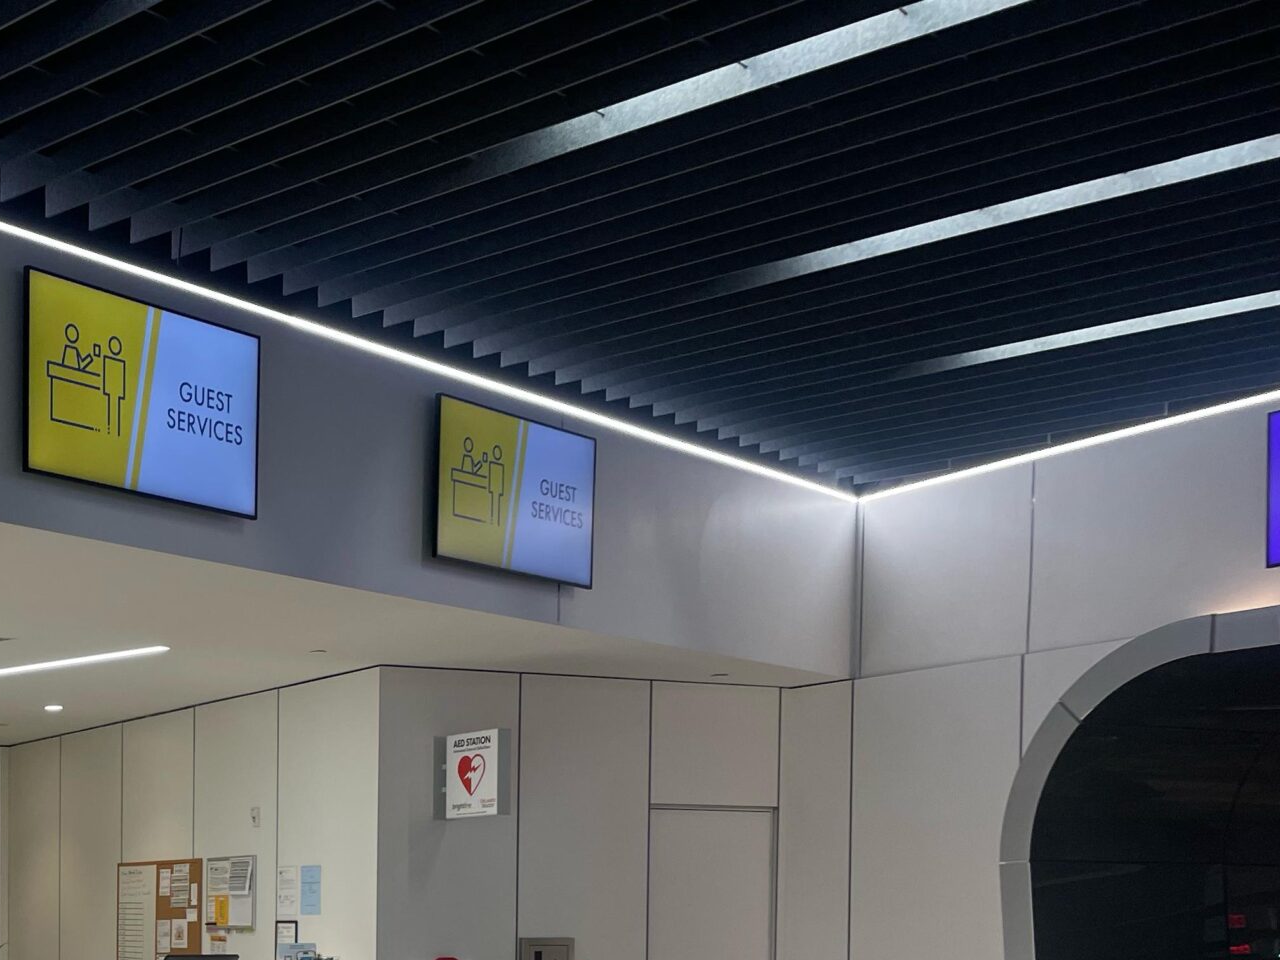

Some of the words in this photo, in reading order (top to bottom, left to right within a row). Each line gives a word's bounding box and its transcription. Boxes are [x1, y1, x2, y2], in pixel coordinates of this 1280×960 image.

[179, 382, 233, 414] GUEST
[167, 408, 243, 445] SERVICES
[540, 479, 577, 503] GUEST
[531, 501, 583, 529] SERVICES
[453, 739, 465, 748] AED
[466, 735, 491, 746] STATION
